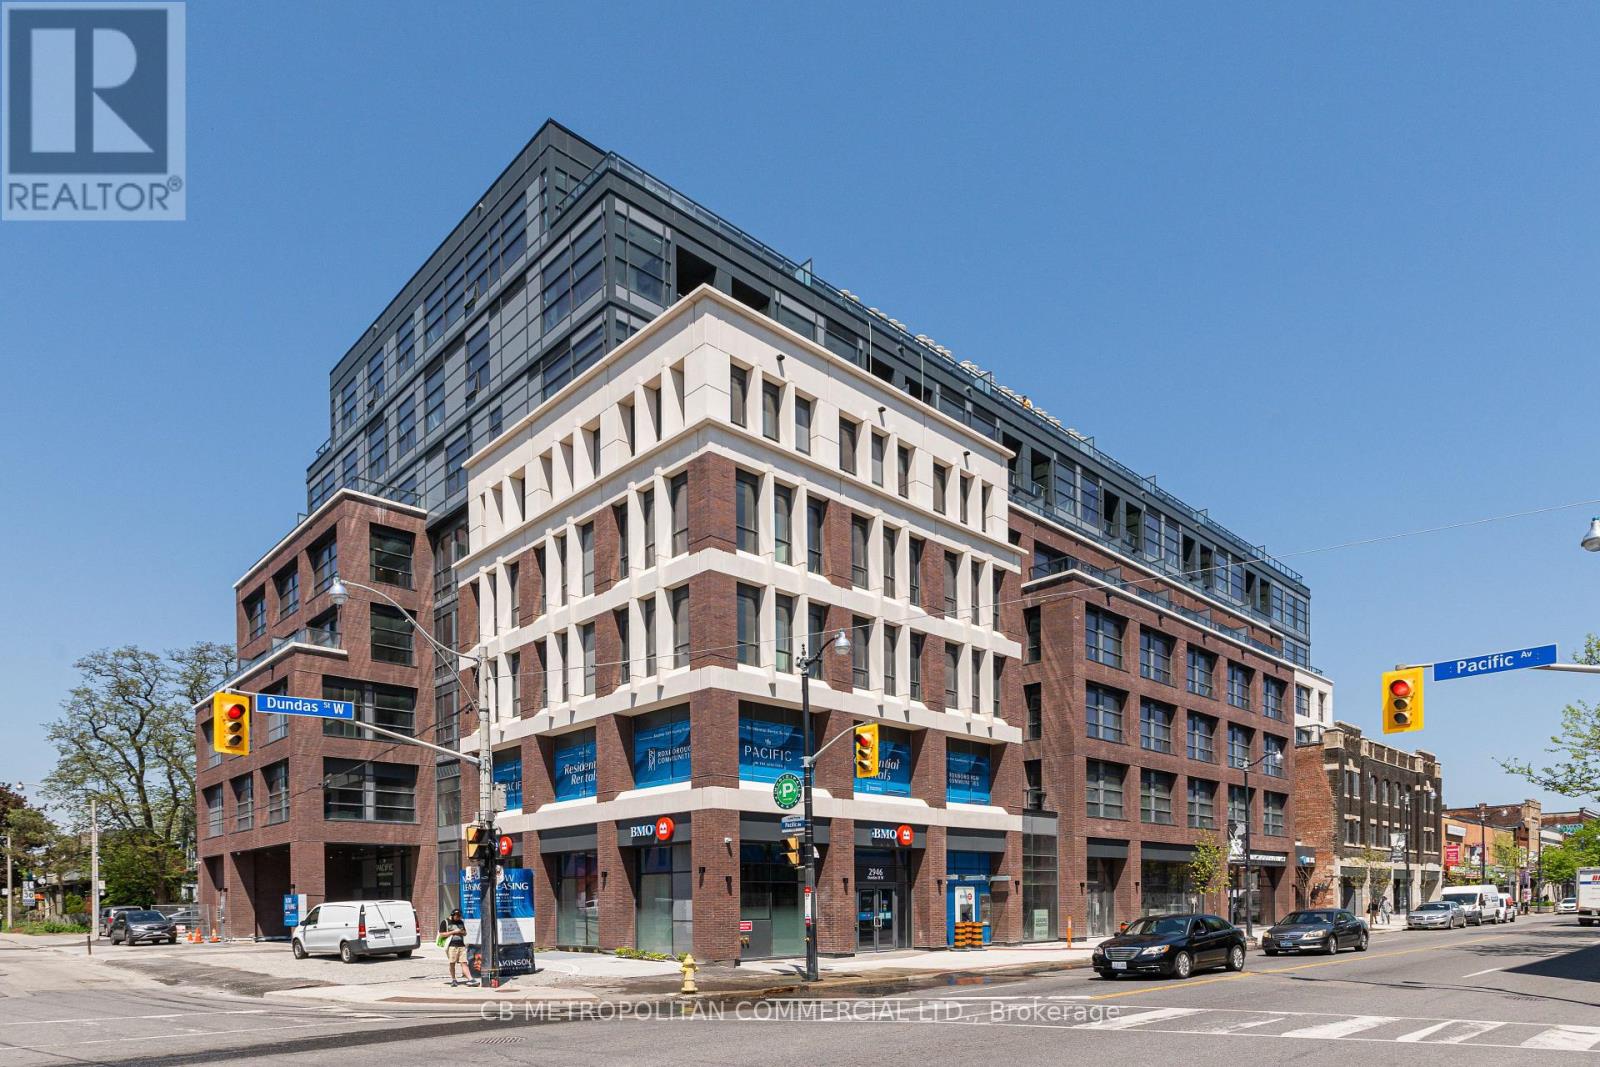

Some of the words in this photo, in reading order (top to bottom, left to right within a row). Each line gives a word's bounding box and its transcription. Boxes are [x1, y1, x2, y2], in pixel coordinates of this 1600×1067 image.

[1456, 653, 1514, 674] Pacific
[1520, 650, 1532, 659] Av
[267, 697, 318, 713] Dundas
[333, 702, 345, 715] W
[657, 752, 691, 765] COMMUNITI
[744, 745, 792, 762] PACIFIC
[564, 760, 597, 775] Resident
[571, 771, 597, 785] Rental
[782, 783, 794, 798] P
[630, 824, 654, 838] BMO
[873, 828, 897, 839] BMO
[868, 867, 883, 876] 2946
[496, 882, 529, 891] EASING
[498, 959, 531, 967] LKINSON
